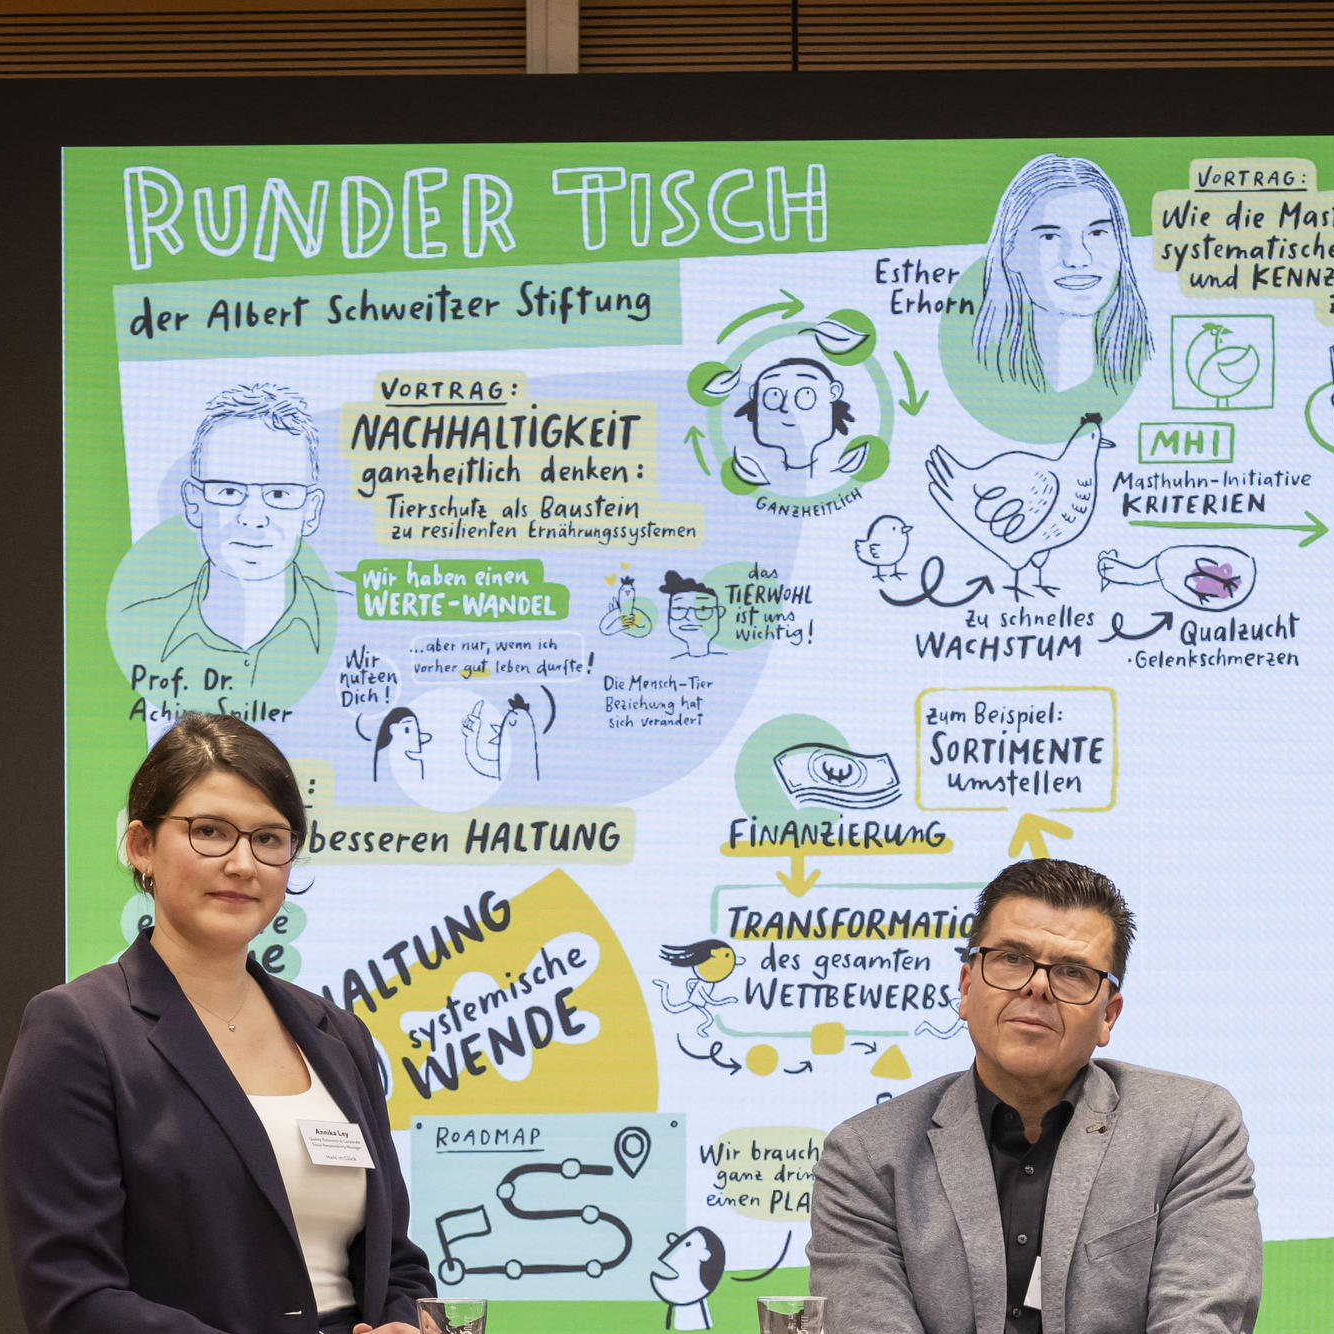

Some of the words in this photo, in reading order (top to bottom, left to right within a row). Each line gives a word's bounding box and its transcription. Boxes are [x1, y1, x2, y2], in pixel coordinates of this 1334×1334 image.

[1198, 165, 1307, 188] VORTRAG:
[122, 165, 516, 271] RUNDER
[552, 163, 828, 250] TISCH
[1162, 199, 1211, 230] Wie
[1225, 199, 1265, 232] die
[875, 257, 961, 285] Esther
[1189, 263, 1239, 291] und
[129, 296, 190, 340] der
[206, 295, 311, 333] Albert
[327, 284, 501, 325] Schweitzer
[515, 280, 651, 325] Stiftung
[890, 287, 975, 316] Erhorn
[380, 377, 518, 401] VORTRAG:
[350, 401, 642, 452] NACHHALTIGKEIT
[1150, 430, 1219, 457] MHI
[357, 453, 521, 499] ganzheitlich
[540, 454, 644, 484] denken:
[1112, 468, 1312, 493] Masthuhn-Initiative
[386, 492, 488, 520] Tierschutz
[501, 497, 528, 519] als
[540, 494, 639, 520] Baustein
[756, 486, 862, 519] GANZHEITLICH
[1122, 492, 1266, 518] KRITERIEN
[391, 525, 413, 541] zu
[421, 517, 517, 540] resilienten
[528, 519, 697, 547] Ernährungssystemen
[363, 567, 397, 589] Wir
[406, 566, 466, 586] haben
[475, 567, 528, 585] einen
[747, 561, 779, 581] das
[363, 590, 556, 617] WERTE-WANDEL
[724, 582, 813, 607] TIERWOHL
[735, 605, 760, 629] ist
[763, 610, 796, 624] uns
[964, 609, 989, 629] zu
[1000, 604, 1095, 629] schnelles
[461, 640, 491, 656] nur,
[495, 641, 532, 652] wenn
[538, 637, 558, 651] ich
[735, 618, 814, 647] wichtig!
[915, 631, 1082, 663] WACHSTUM
[1180, 611, 1300, 647] Qualzucht
[345, 644, 380, 670] Wir
[413, 658, 458, 675] vorher
[461, 658, 489, 680] gut
[495, 659, 531, 675] leben
[130, 664, 188, 699] Prof.
[203, 667, 234, 692] Dr.
[339, 668, 398, 689] nutzen
[603, 674, 625, 692] Die
[628, 674, 714, 693] Mensch-Tier
[129, 697, 208, 722] Achi
[340, 685, 390, 708] Dich!
[605, 694, 676, 716] Beziehung
[680, 695, 704, 711] hat
[608, 714, 634, 729] sich
[925, 707, 967, 726] zum
[972, 700, 1064, 730] Beispiel:
[929, 729, 1105, 766] SORTIMENTE
[947, 769, 1082, 797] umstellen
[308, 827, 449, 854] besseren
[464, 818, 621, 855] HALTUNG
[729, 813, 947, 851] FINANZIERUNG
[729, 903, 972, 940] TRANSFORMATIO
[760, 941, 801, 973] des
[812, 947, 931, 981] gesamten
[409, 947, 586, 1051] systemische
[402, 987, 586, 1100] WENDE
[436, 1126, 541, 1149] ROADMAP
[699, 1141, 741, 1167] Wir
[752, 1138, 819, 1161] brauch
[712, 1169, 764, 1191] ganz
[774, 1164, 815, 1182] drin
[706, 1193, 760, 1207] einen
[770, 1190, 810, 1214] PLA
